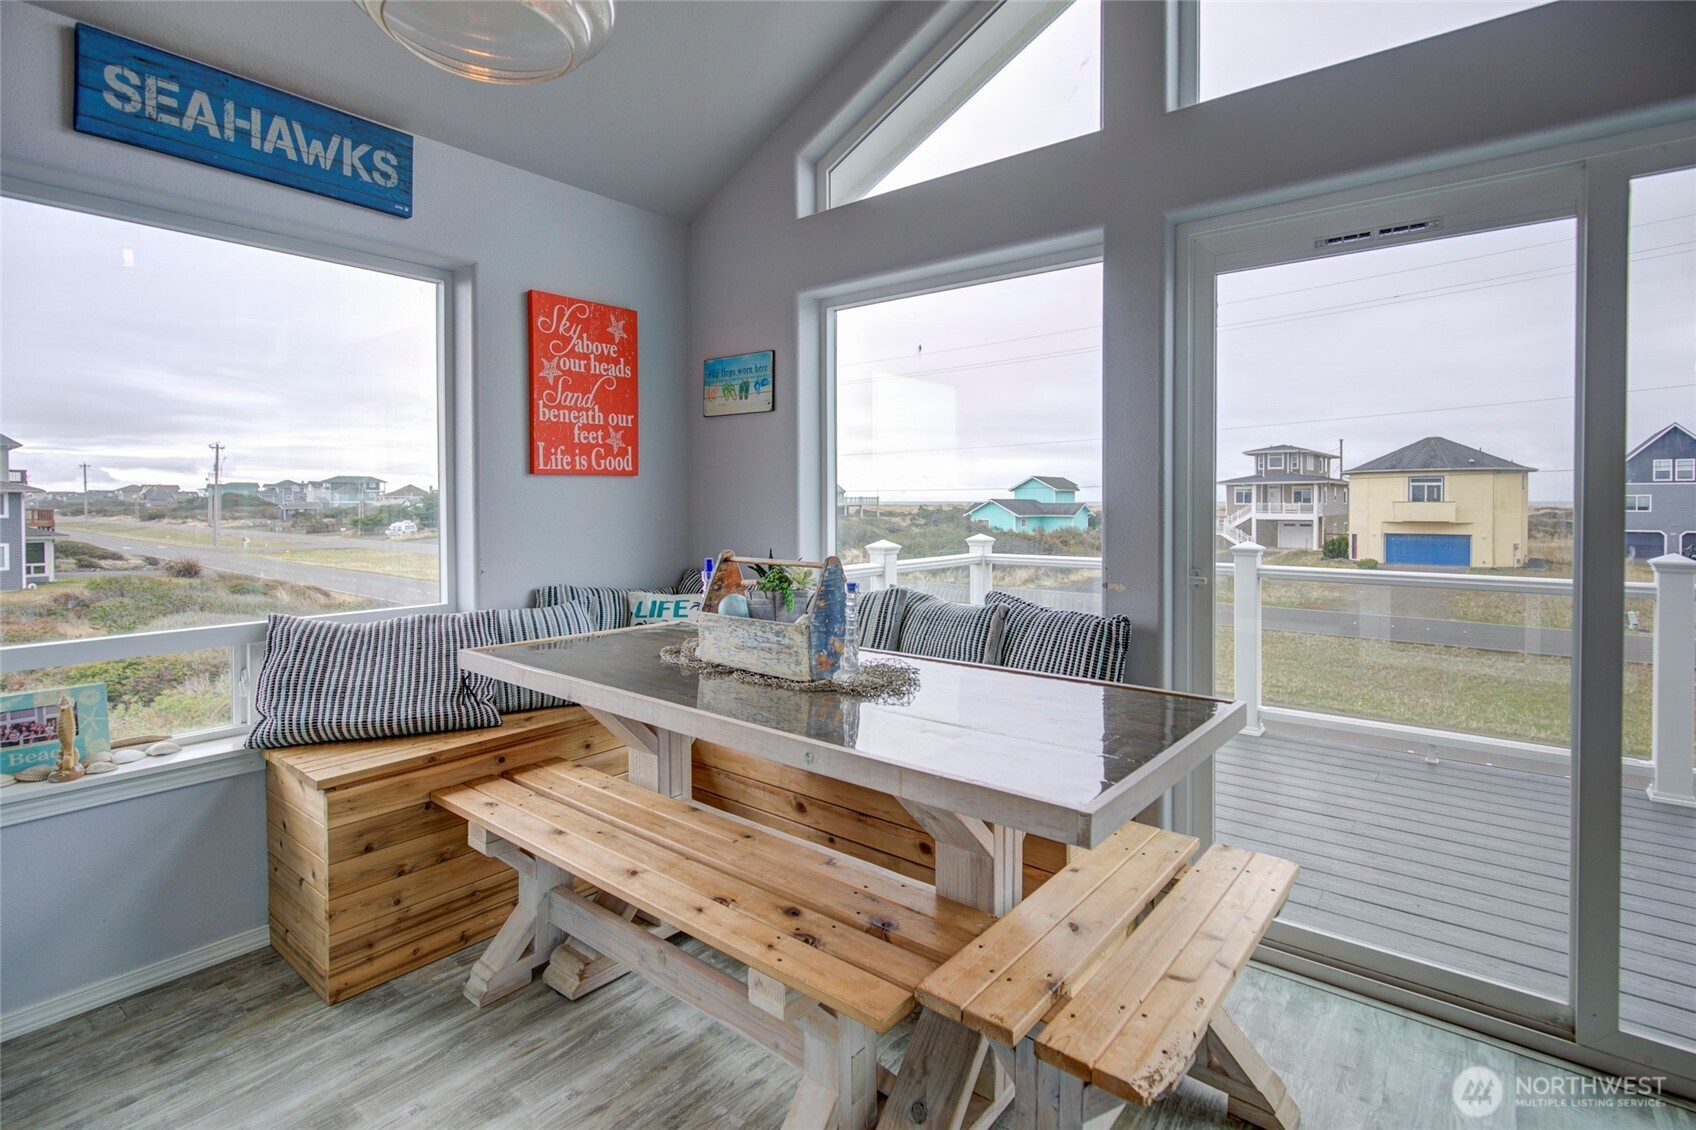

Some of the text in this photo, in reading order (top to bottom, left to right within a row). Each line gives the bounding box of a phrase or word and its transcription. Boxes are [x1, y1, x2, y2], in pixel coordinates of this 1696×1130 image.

[102, 64, 399, 188] SEAHAWKS
[538, 303, 590, 356] Sky
[574, 333, 618, 357] above
[559, 354, 632, 378] our heads
[737, 366, 753, 374] worn
[543, 376, 617, 408] Sand
[538, 400, 634, 427] beneath our
[573, 422, 604, 444] feet
[537, 441, 633, 471] Life is Good
[635, 599, 690, 618] LIFE
[8, 748, 60, 766] Beac
